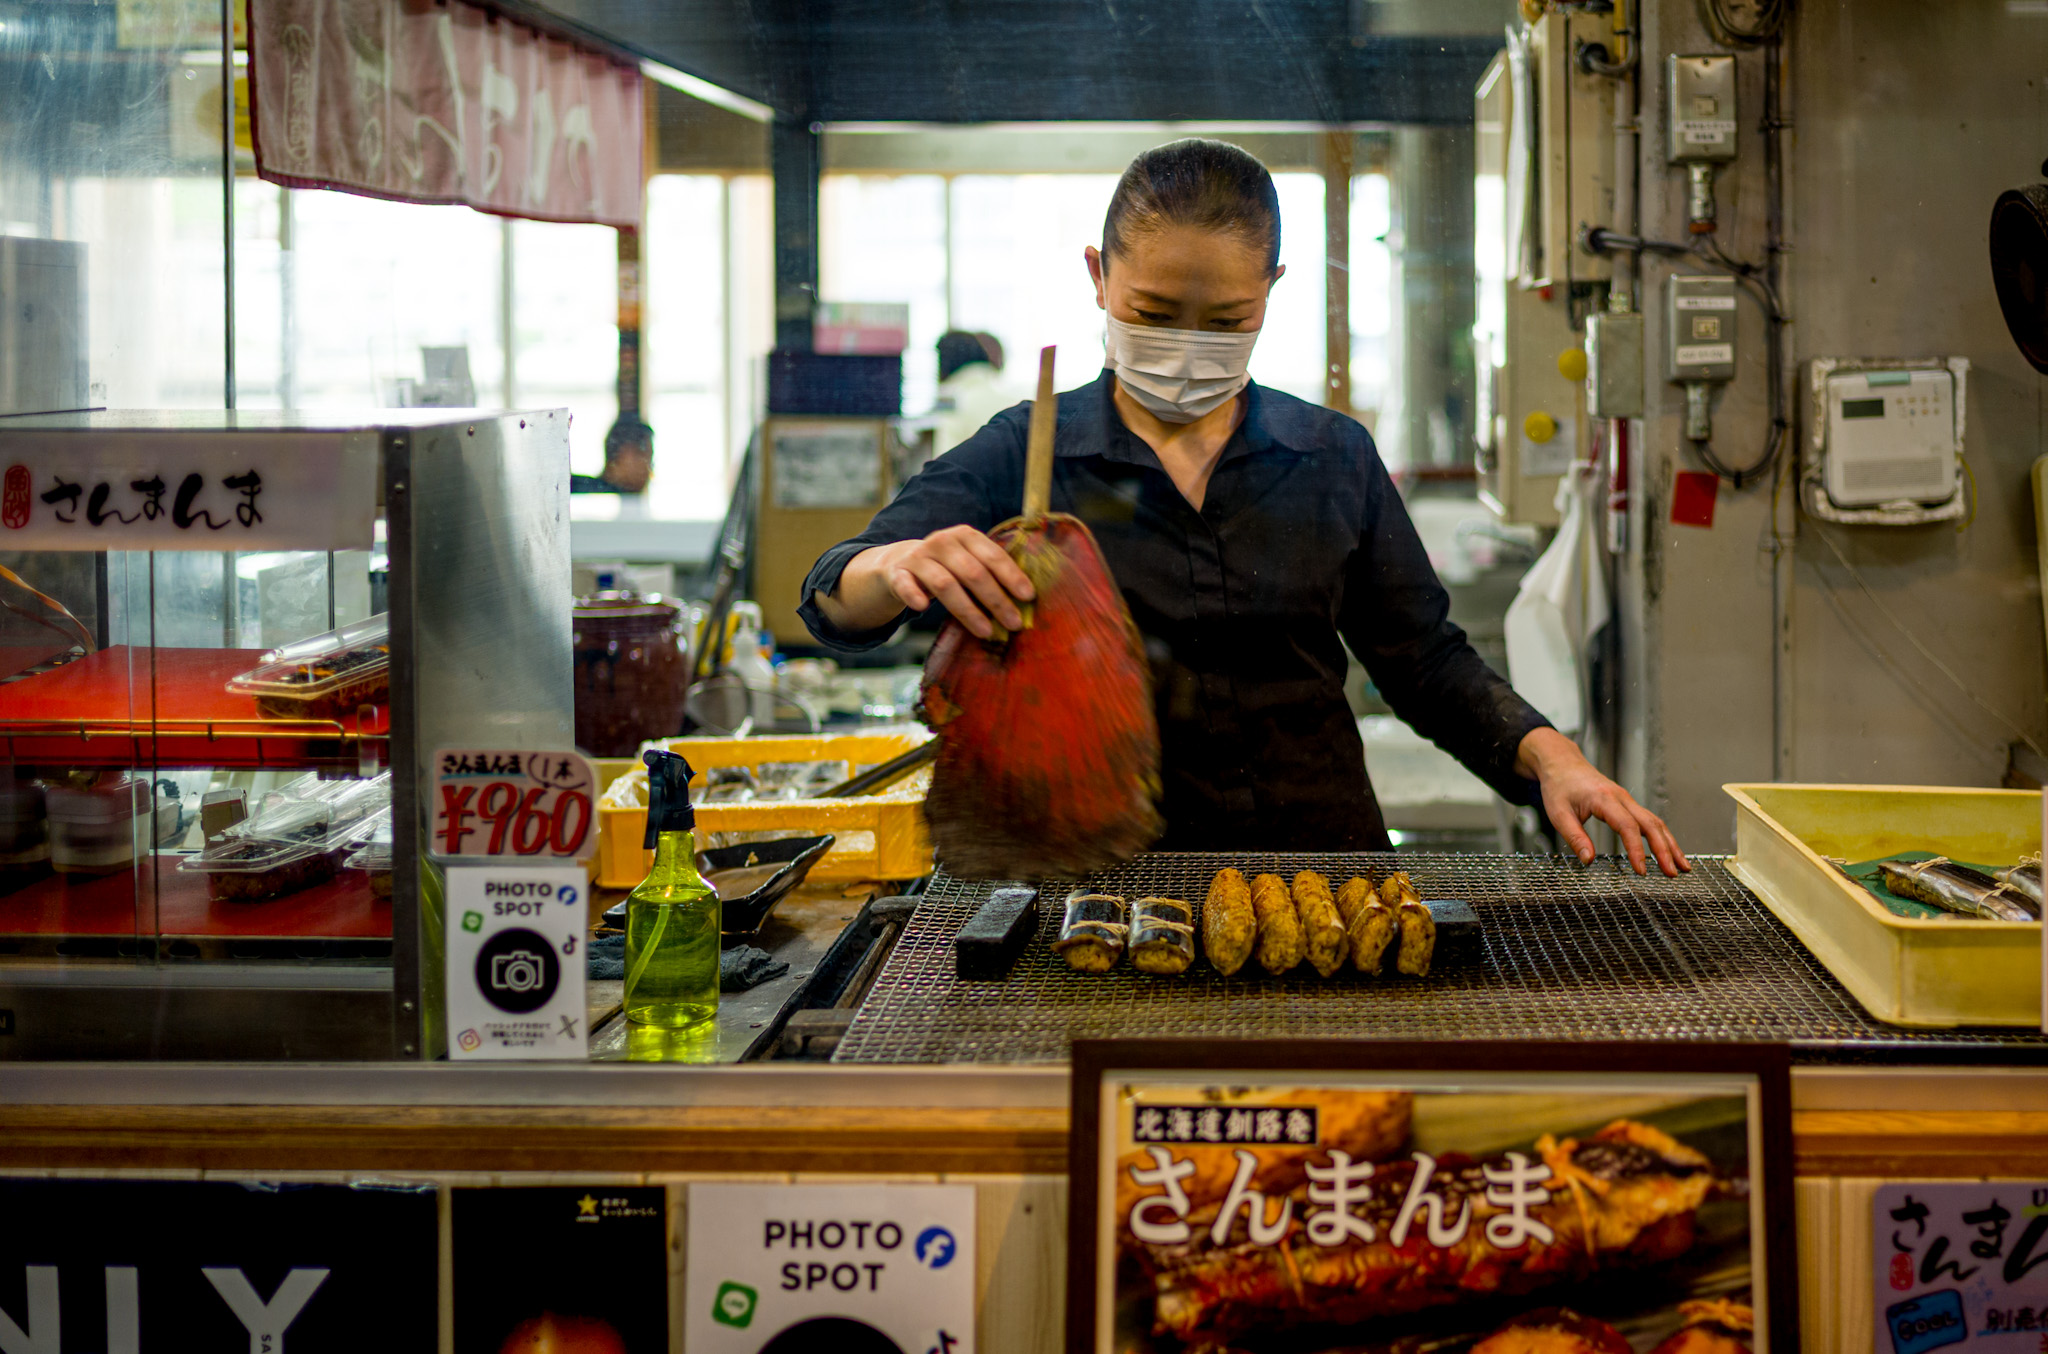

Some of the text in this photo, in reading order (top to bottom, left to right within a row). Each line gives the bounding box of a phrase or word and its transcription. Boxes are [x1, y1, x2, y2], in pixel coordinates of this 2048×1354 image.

[40, 469, 263, 529] さんまんま
[441, 754, 522, 774] さんまんま
[437, 782, 592, 857] ¥960
[485, 882, 552, 898] PHOTO
[493, 901, 545, 917] SPOT
[1136, 1108, 1314, 1142] 北海道釧路発
[1128, 1145, 1556, 1249] さんまんま
[763, 1220, 904, 1250] PHOTO
[779, 1262, 886, 1292] SPOT
